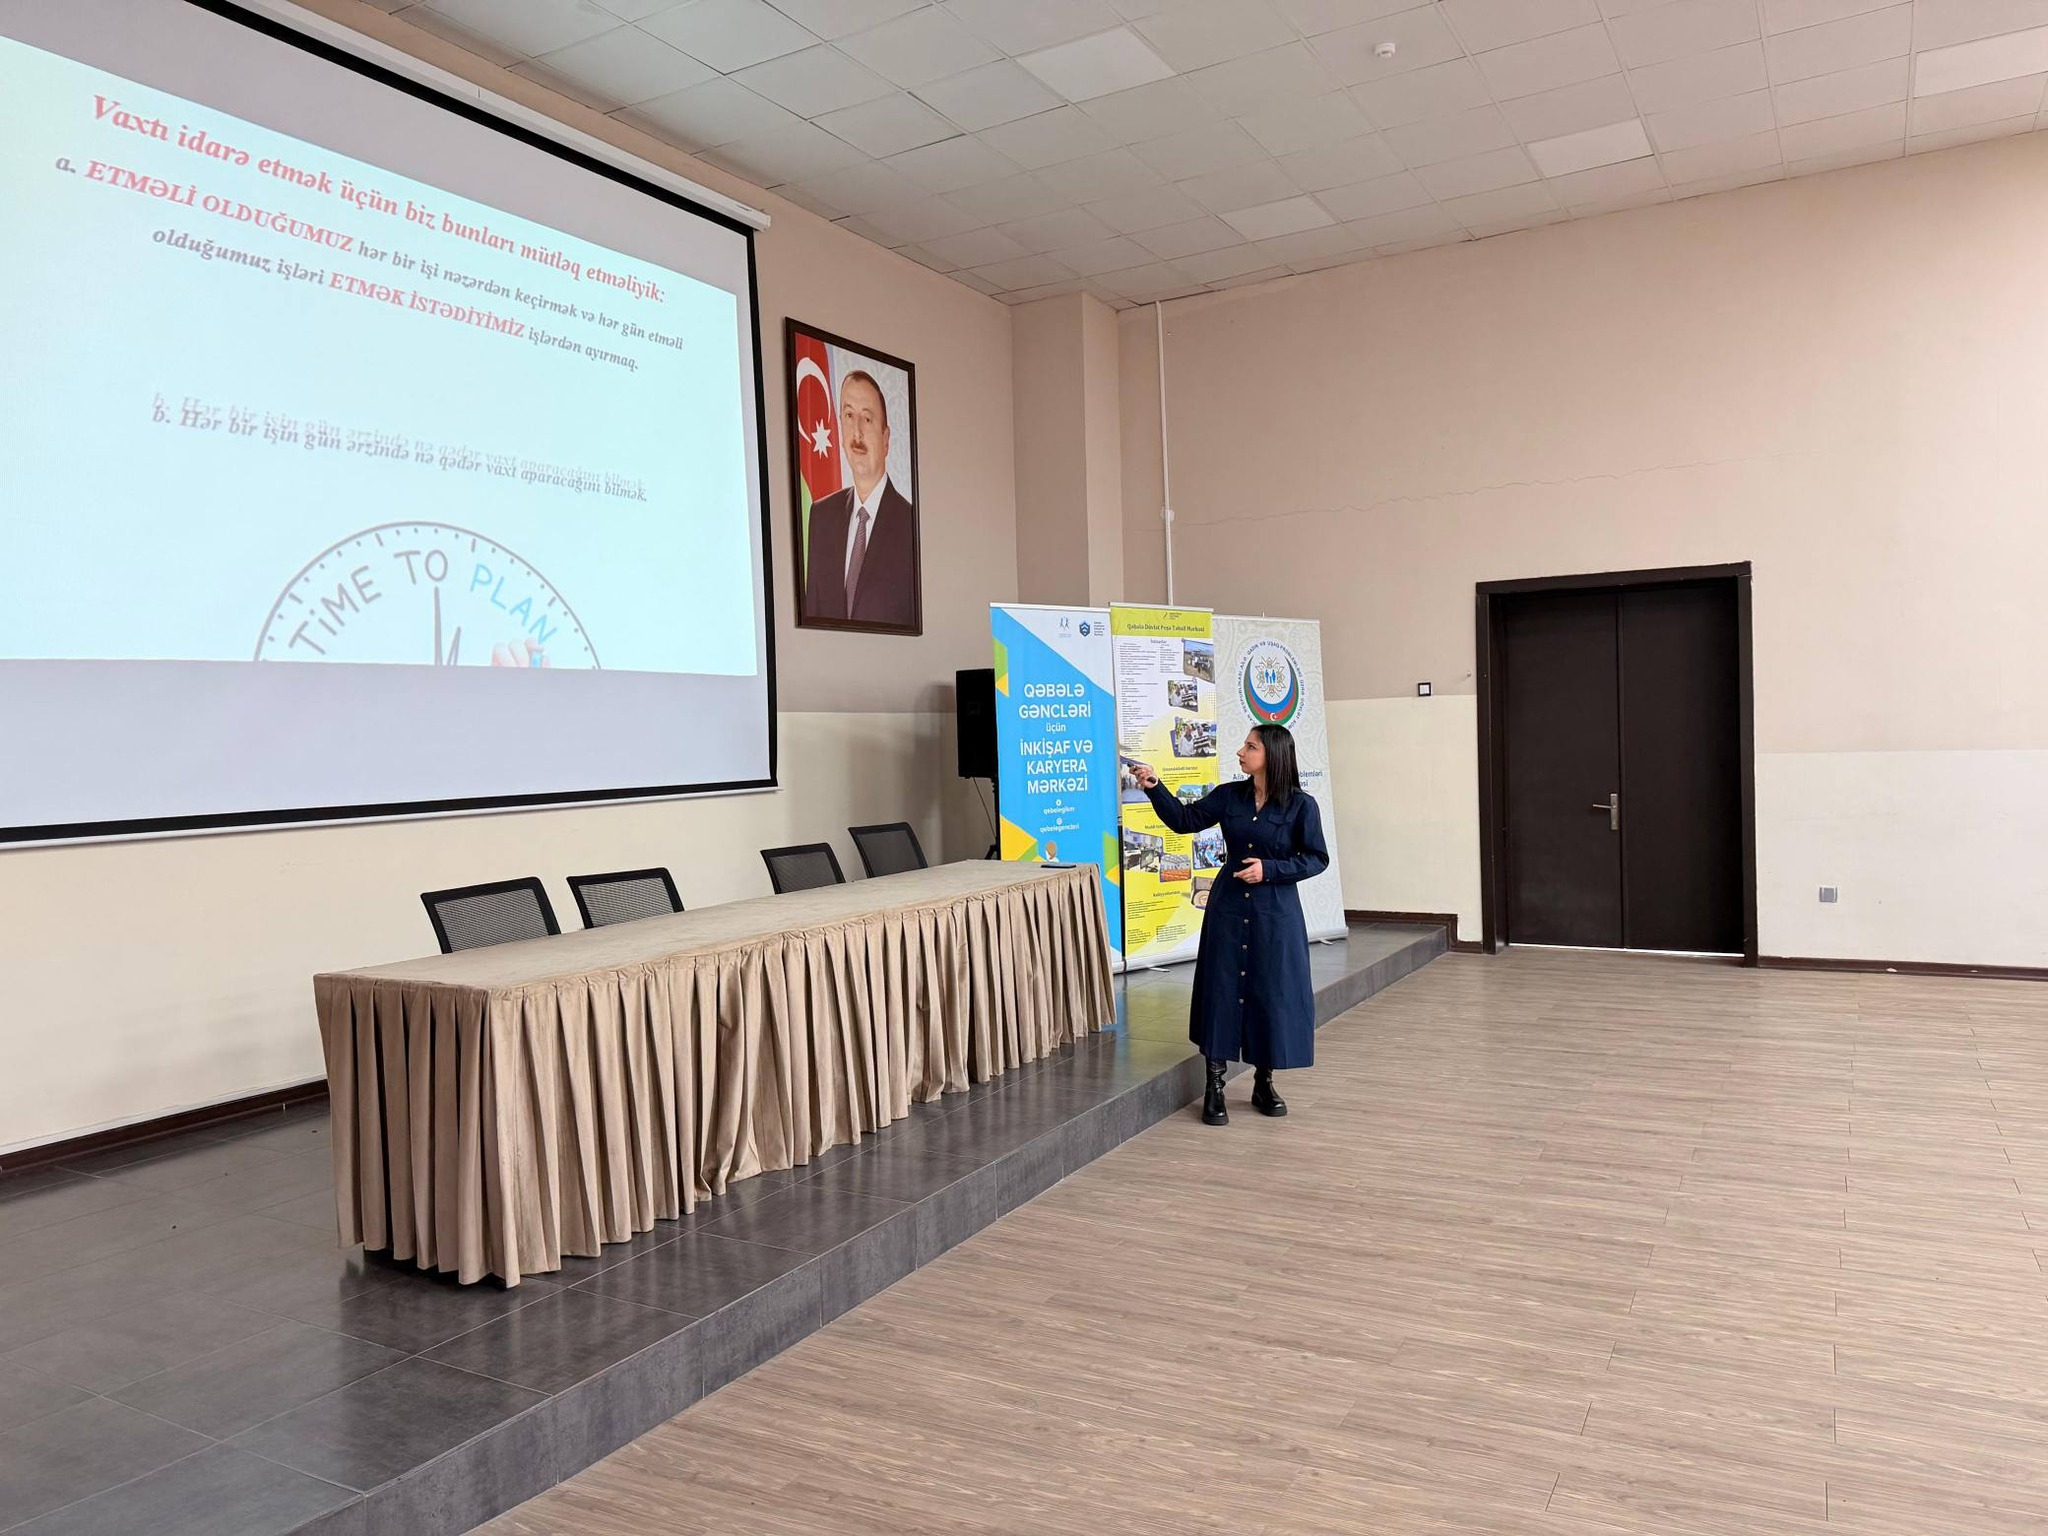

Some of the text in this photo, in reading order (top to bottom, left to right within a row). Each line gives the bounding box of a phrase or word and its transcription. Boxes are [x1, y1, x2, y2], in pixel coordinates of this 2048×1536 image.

[93, 95, 169, 142] Vaxtı
[177, 125, 250, 166] idarə
[258, 157, 332, 195] etmək
[340, 179, 398, 216] üçün
[405, 200, 436, 230] biz
[442, 213, 515, 254] bunları
[520, 244, 581, 280] mütləq
[55, 156, 684, 351] a. ETMƏLİ OLDUĞUMUZ hər bir işi nəzərdən keçirmək və hər gün etməli
[152, 227, 271, 273] olduğumuz
[276, 258, 325, 286] işləri
[328, 271, 405, 306] ETMƏK
[409, 289, 525, 338] İSTƏDİYİMİZ
[528, 326, 582, 354] işlərdən
[179, 408, 222, 432] Hər
[228, 416, 257, 437] bir
[263, 422, 299, 445] işin
[303, 429, 341, 450] gün
[415, 449, 434, 464] nə
[486, 462, 517, 478] vaxt
[393, 549, 449, 585] TO
[470, 563, 558, 645] PLAN
[1023, 683, 1085, 698] QƏBƏLƏ
[1018, 700, 1091, 719] GƏNCLƏRİ
[1046, 722, 1066, 734] üçün
[1020, 738, 1093, 758] İNKİŞAF VƏ
[1026, 758, 1088, 775] KARYERA
[1027, 774, 1088, 794] MƏRKƏZİ
